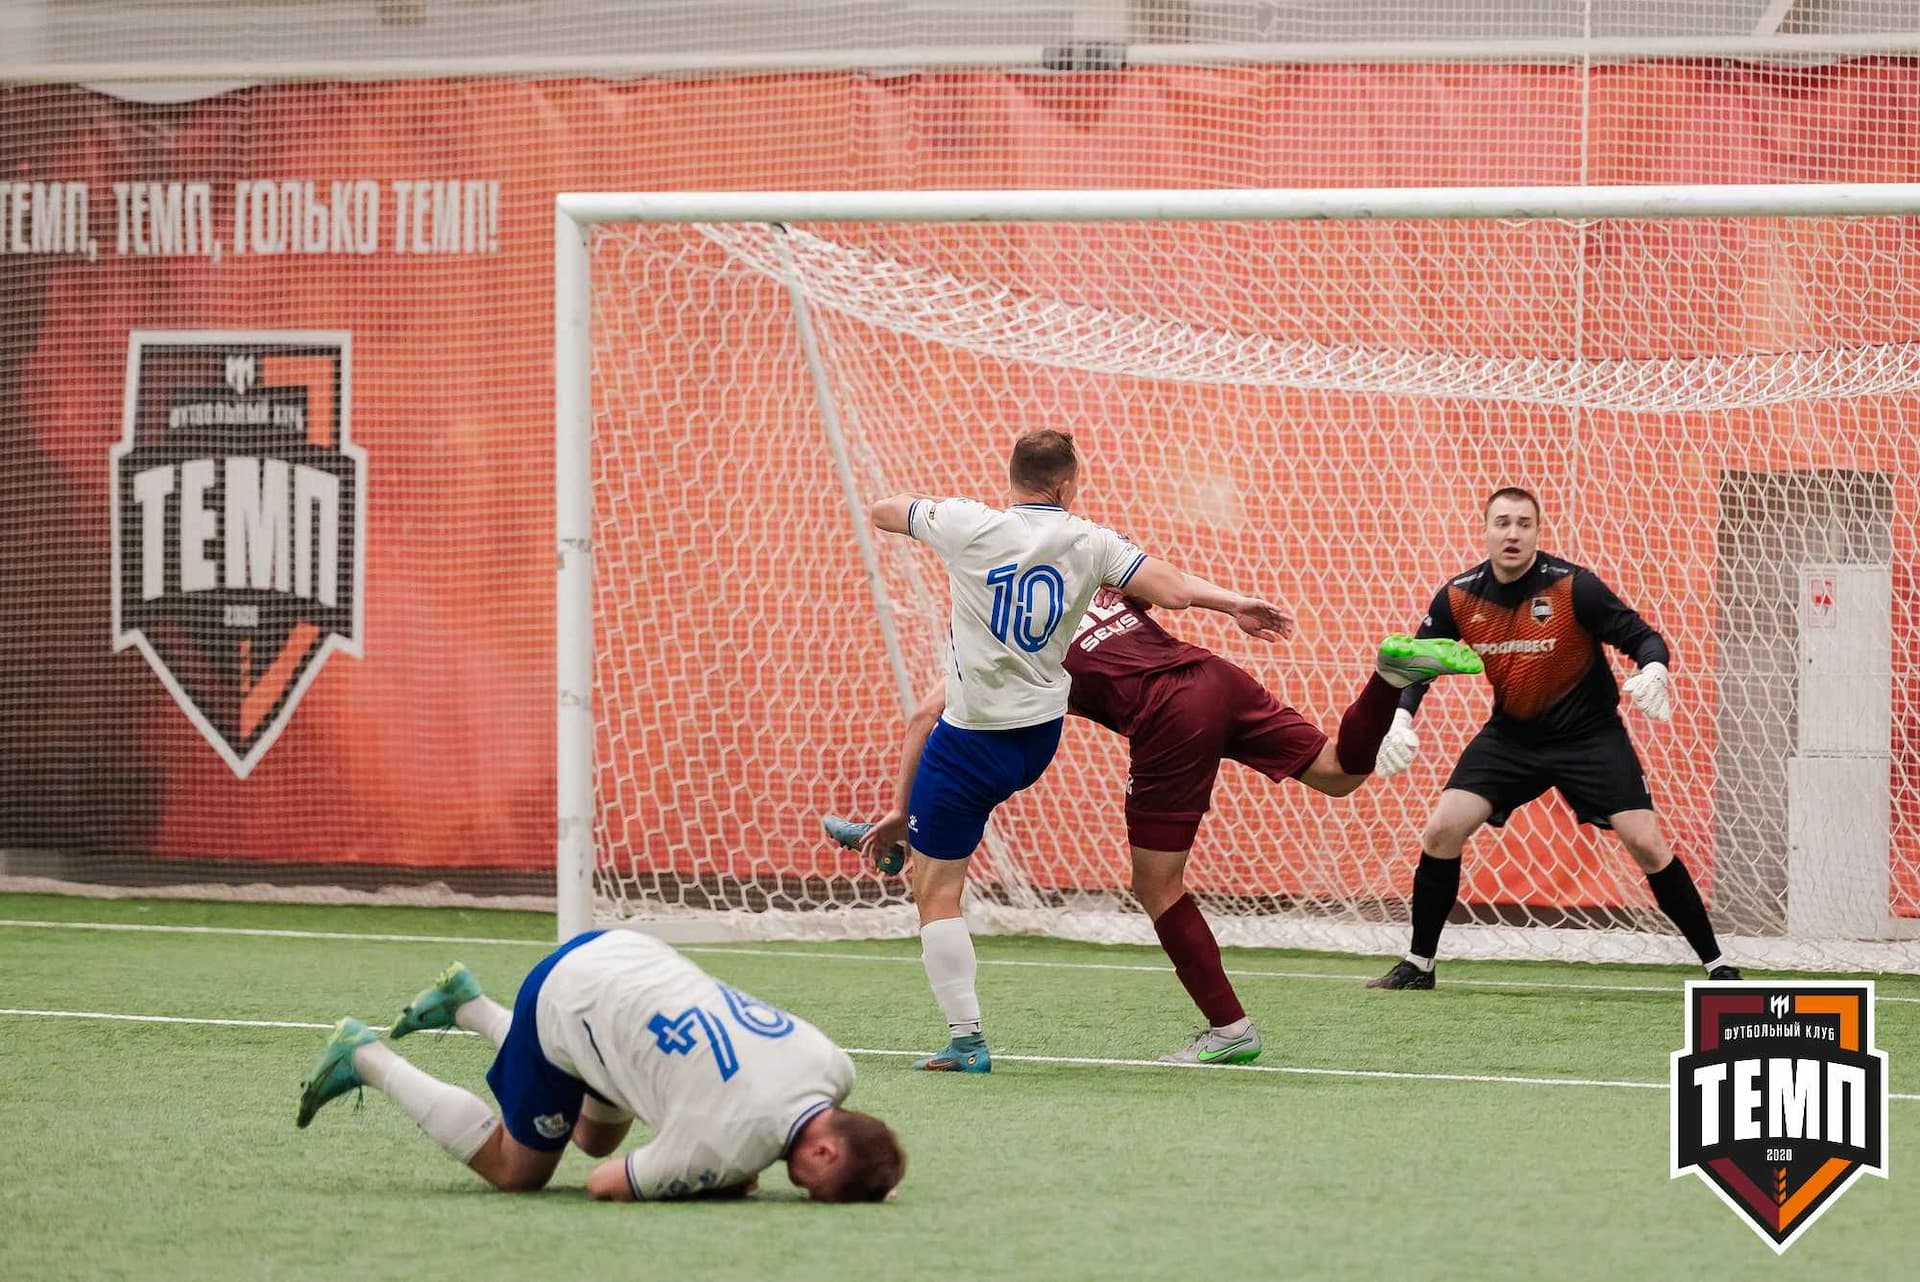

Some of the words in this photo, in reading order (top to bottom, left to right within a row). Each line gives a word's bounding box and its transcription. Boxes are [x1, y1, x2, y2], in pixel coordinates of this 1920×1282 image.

[113, 181, 222, 261] ТЕМП,
[393, 179, 499, 254] ТЕМП!
[133, 456, 339, 609] ТЕМП
[986, 562, 1065, 654] 10
